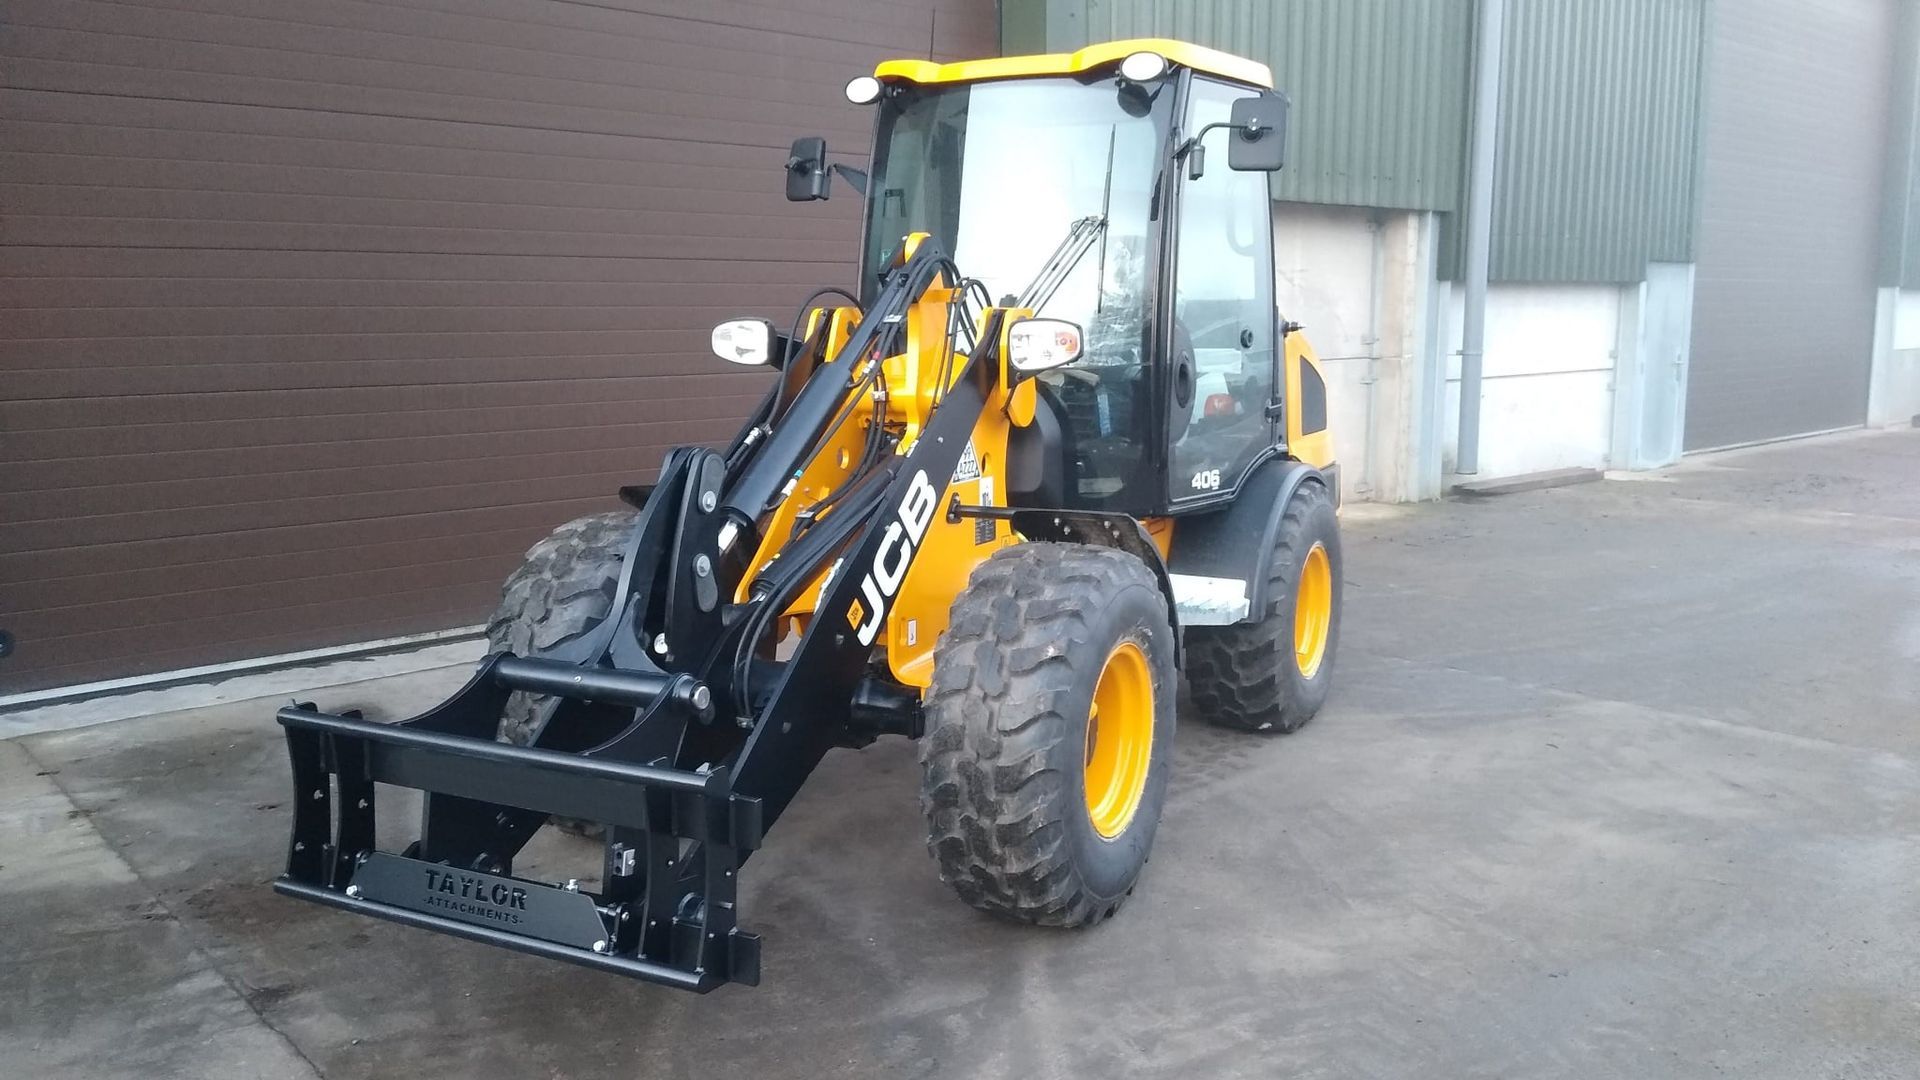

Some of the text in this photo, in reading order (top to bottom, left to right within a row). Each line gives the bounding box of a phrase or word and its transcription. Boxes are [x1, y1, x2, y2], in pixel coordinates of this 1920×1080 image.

[1191, 469, 1220, 490] 406
[857, 469, 937, 647] JCB
[425, 868, 527, 911] TAYLOR
